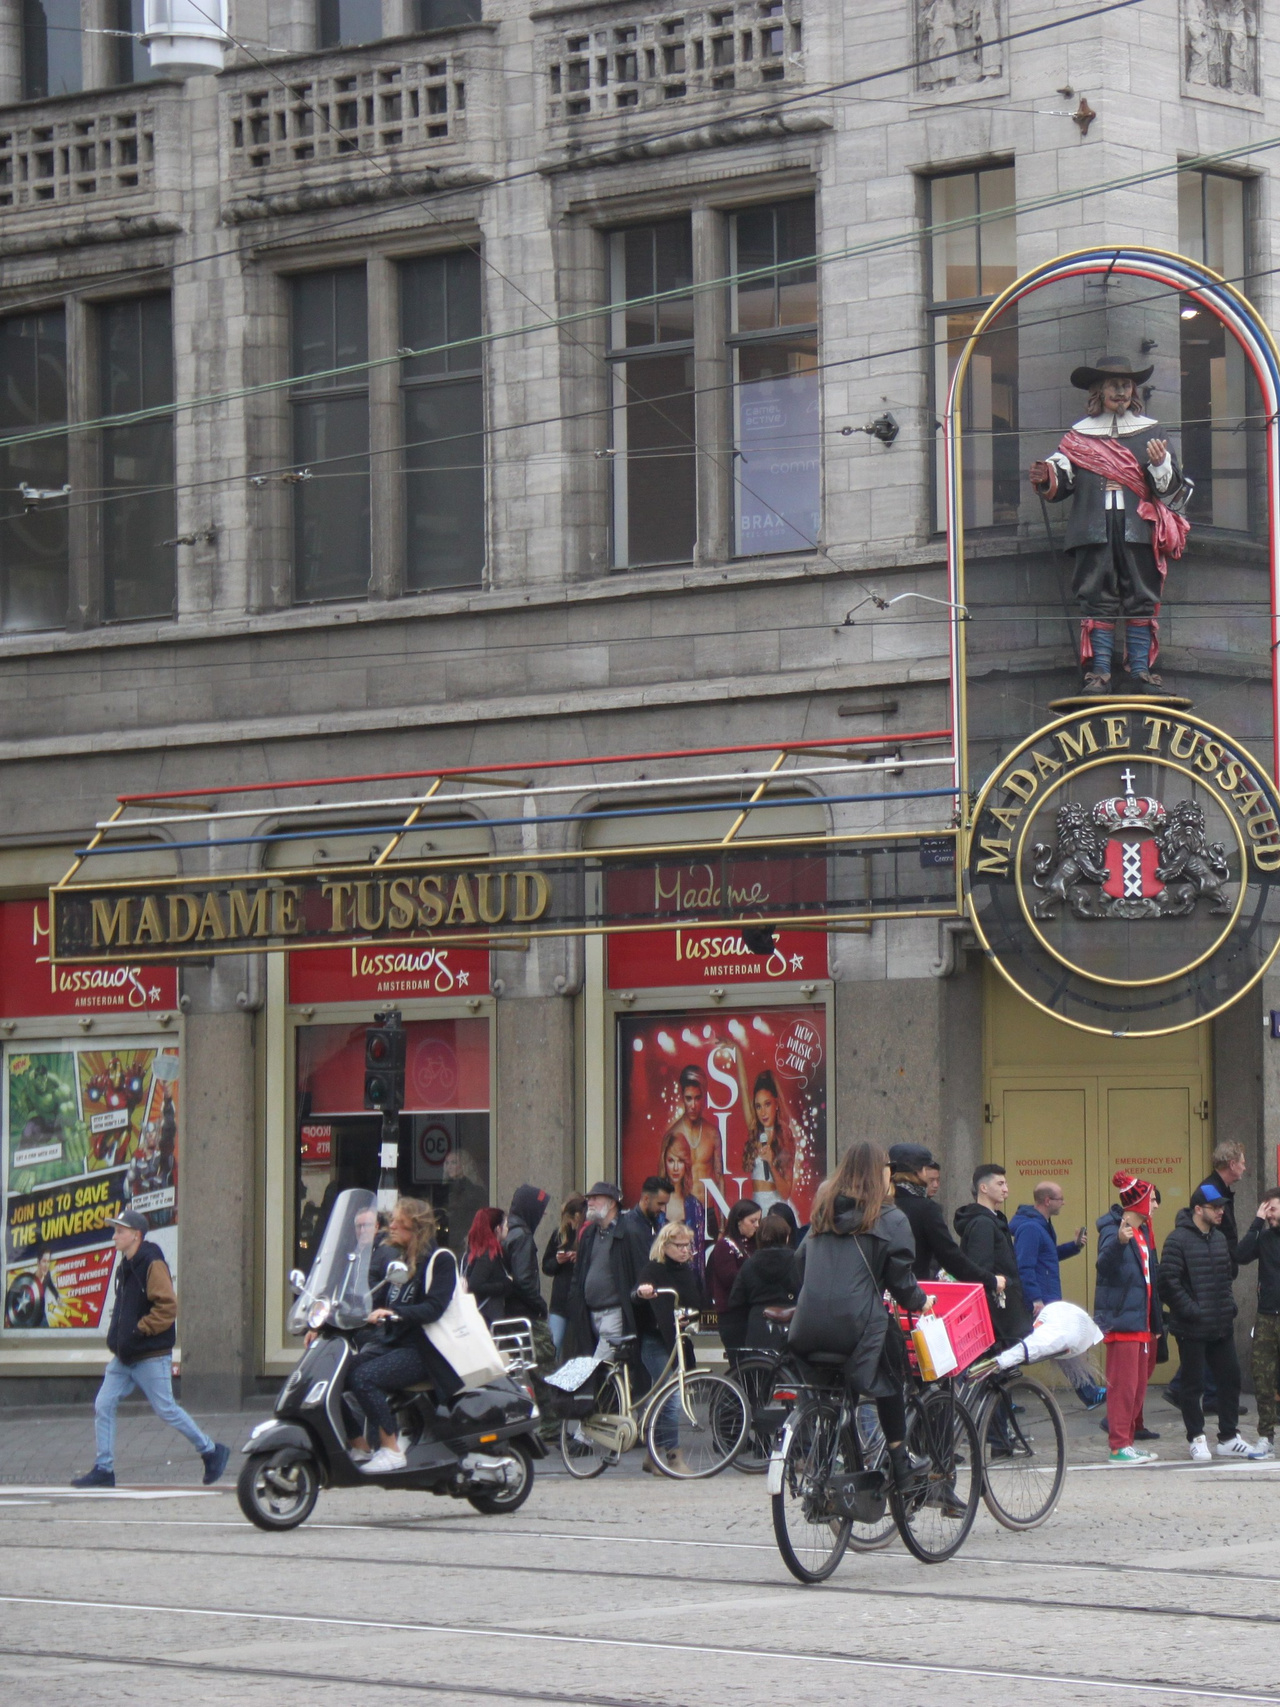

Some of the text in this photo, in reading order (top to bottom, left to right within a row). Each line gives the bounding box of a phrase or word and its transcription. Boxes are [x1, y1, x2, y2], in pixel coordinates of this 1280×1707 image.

[741, 512, 786, 531] BRAX
[974, 716, 1131, 876] MADAME
[90, 886, 302, 948] MADAME
[321, 871, 549, 933] TUSSAUD
[703, 963, 761, 977] AMSTERDAM
[376, 979, 431, 992] AMSTERDAM
[74, 995, 125, 1007] AMSTERDAM
[795, 1023, 814, 1043] NEW
[698, 1046, 749, 1268] SIN
[1015, 1158, 1074, 1167] NOODUITGANG
[1114, 1156, 1183, 1165] EMERGENCY EXIT
[1019, 1168, 1070, 1176] VRIJHOUDEN
[1124, 1167, 1174, 1175] KEEP CLEAR
[10, 1180, 110, 1226] JOIN US TO SAVE
[10, 1200, 121, 1248] THE UNIVERSE!
[79, 1267, 109, 1282] AVENGERS
[67, 1283, 102, 1297] EXPERIENCE
